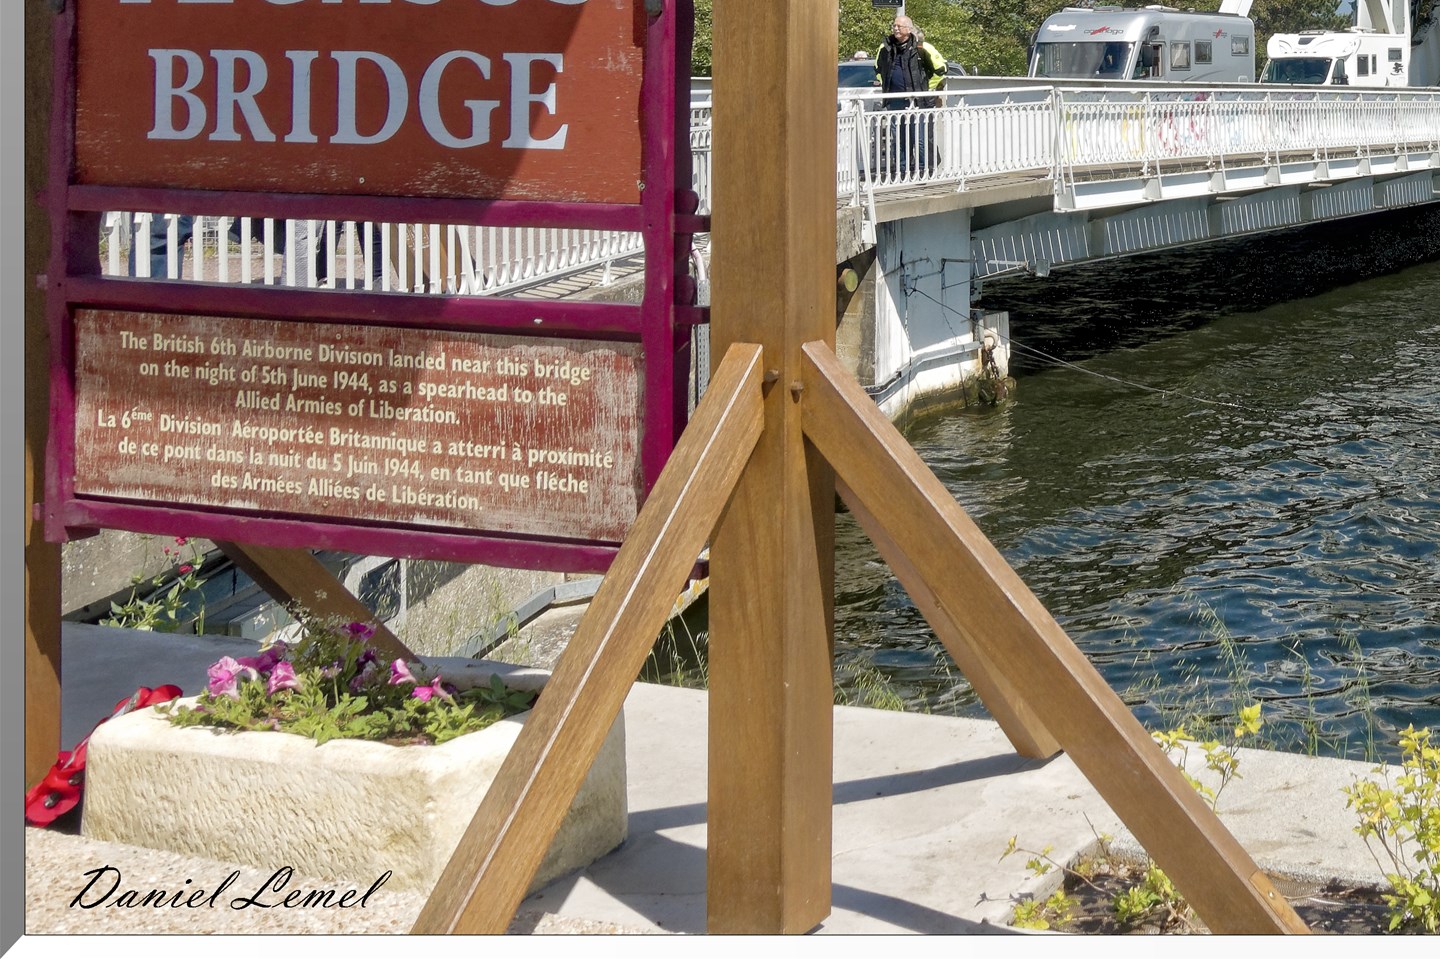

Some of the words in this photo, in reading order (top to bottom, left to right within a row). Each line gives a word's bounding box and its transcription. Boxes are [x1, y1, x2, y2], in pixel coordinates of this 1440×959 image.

[146, 48, 569, 150] BRIDGE
[120, 331, 147, 350] The
[153, 334, 204, 354] British
[210, 337, 236, 356] 6th
[242, 339, 312, 361] Airborne
[319, 344, 383, 367] Division
[389, 349, 445, 370] landed
[452, 359, 490, 373] near
[496, 359, 528, 376] this
[534, 360, 590, 385] bridge
[139, 362, 159, 376] on
[165, 360, 190, 378] the
[196, 362, 236, 385] night
[241, 365, 257, 382] of
[262, 366, 287, 385] 5th
[292, 372, 327, 391] June
[333, 371, 373, 395] 1944,
[379, 379, 397, 392] as
[403, 381, 413, 394] a
[418, 380, 507, 402] spearhead
[514, 388, 533, 404] to
[538, 388, 567, 406] the
[235, 391, 280, 411] Allied
[285, 394, 342, 416] Armies
[348, 399, 365, 417] of
[370, 401, 460, 425] Liberation.
[98, 409, 116, 428] La
[160, 414, 221, 436] Division
[231, 420, 324, 444] Aéroportée
[330, 427, 426, 456] Britannique
[432, 441, 442, 454] a
[448, 441, 506, 459] atterri
[512, 443, 522, 461] à
[528, 447, 613, 468] proximité
[118, 437, 136, 454] de
[142, 443, 158, 455] ce
[164, 442, 201, 461] pont
[206, 444, 244, 463] dans
[250, 448, 263, 465] la
[268, 449, 301, 468] nuit
[307, 451, 326, 470] du
[333, 454, 342, 471] 5
[347, 455, 378, 477] Juin
[384, 457, 424, 481] 1944,
[431, 466, 450, 480] en
[456, 466, 493, 484] tant
[499, 473, 530, 492] que
[211, 470, 237, 489] des
[242, 472, 302, 494] Armées
[307, 478, 360, 499] Alliées
[366, 484, 386, 502] de
[392, 488, 482, 510] Libération.
